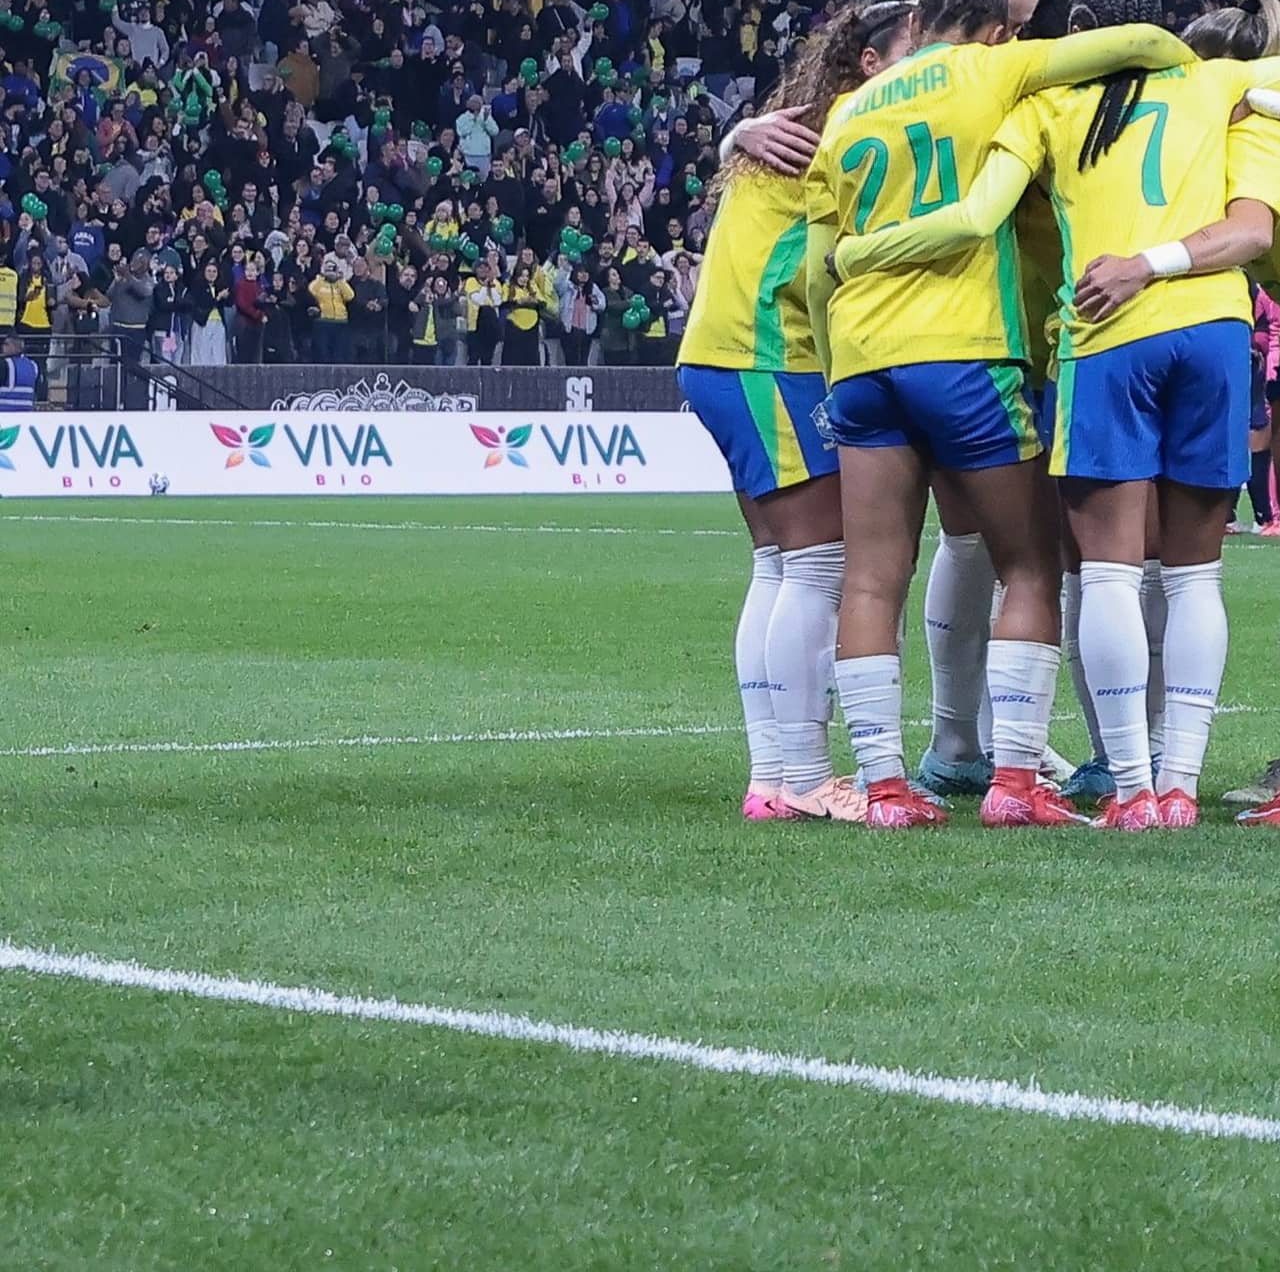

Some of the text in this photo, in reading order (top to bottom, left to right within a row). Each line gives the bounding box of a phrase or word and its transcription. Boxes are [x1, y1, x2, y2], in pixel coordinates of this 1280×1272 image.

[1114, 100, 1169, 207] 7
[840, 121, 960, 236] 24
[29, 424, 144, 468] VIVA
[283, 423, 393, 466] VIVA
[540, 424, 647, 466] VIVA
[62, 475, 122, 488] BIO
[316, 474, 373, 486] BIO
[572, 472, 627, 485] BIO
